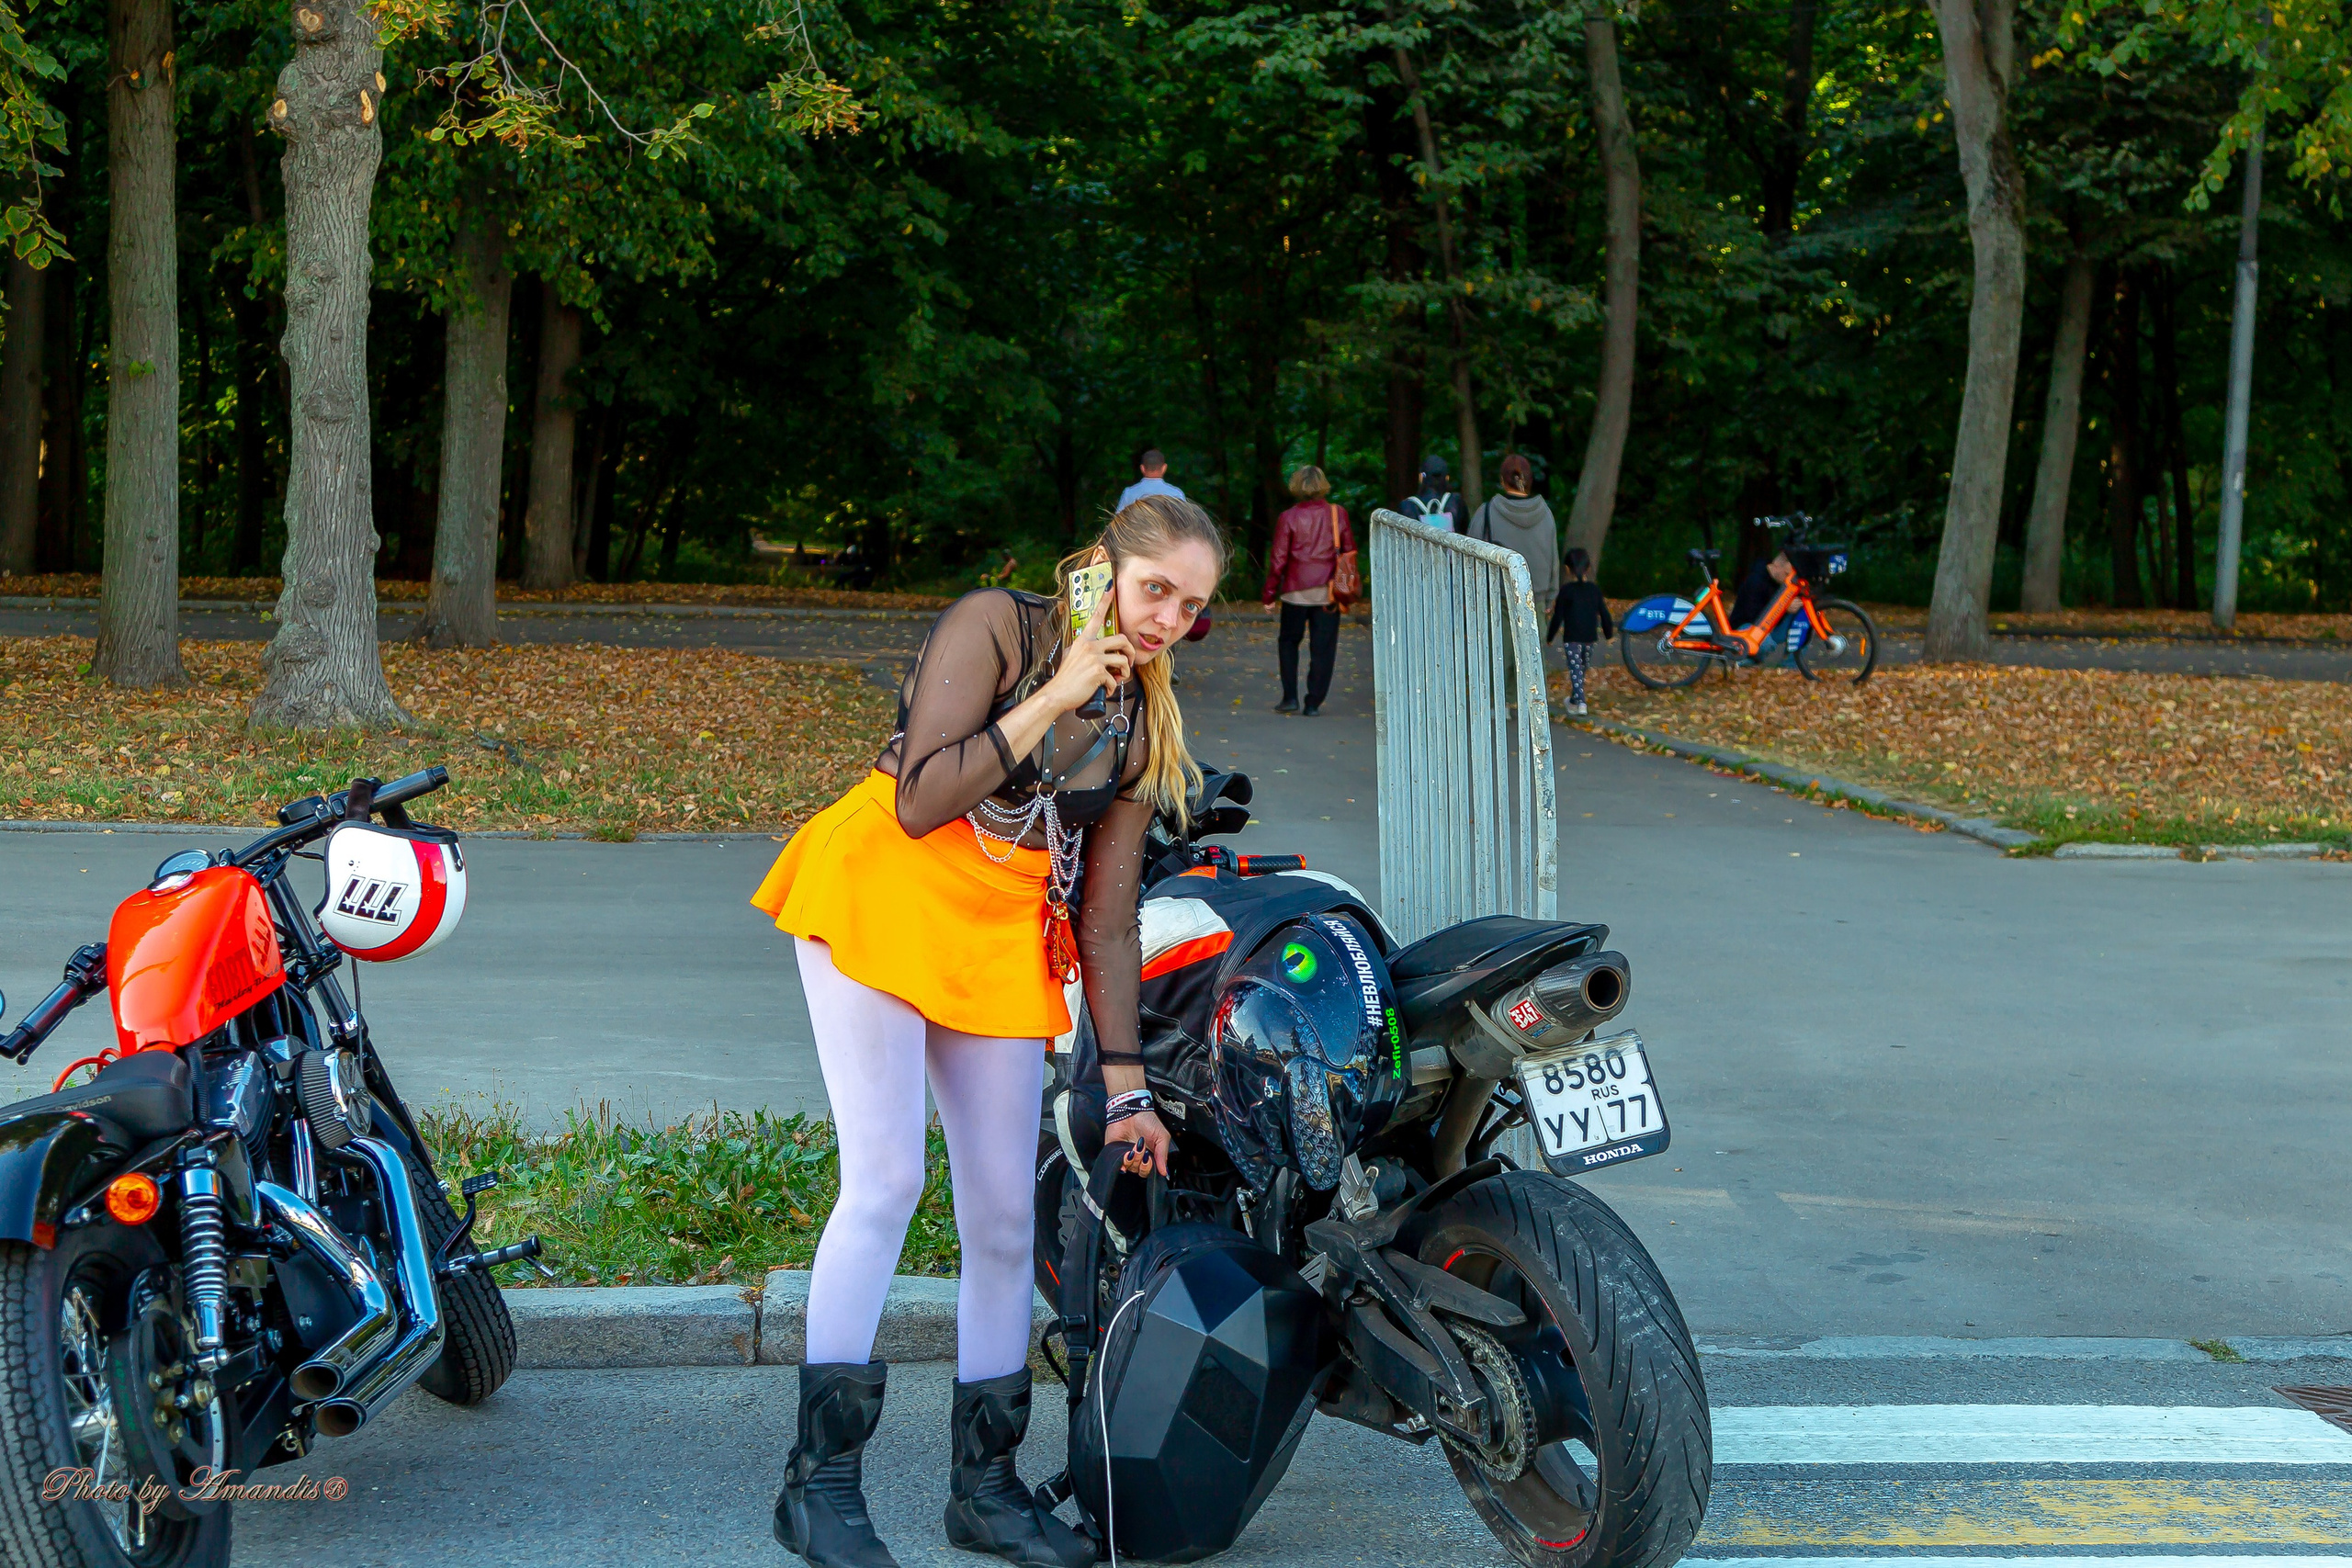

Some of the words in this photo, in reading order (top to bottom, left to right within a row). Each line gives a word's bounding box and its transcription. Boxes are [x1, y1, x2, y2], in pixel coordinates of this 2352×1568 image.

[1323, 919, 1384, 1028] #НЕВЛЮБЛЯЙСЯ
[1385, 1007, 1402, 1080] Zefir0508
[1543, 1048, 1627, 1095] 8580
[1591, 1084, 1620, 1101] RUS
[1607, 1094, 1646, 1134] 77
[1036, 1147, 1063, 1181] CORSE
[1582, 1143, 1645, 1166] HONDA
